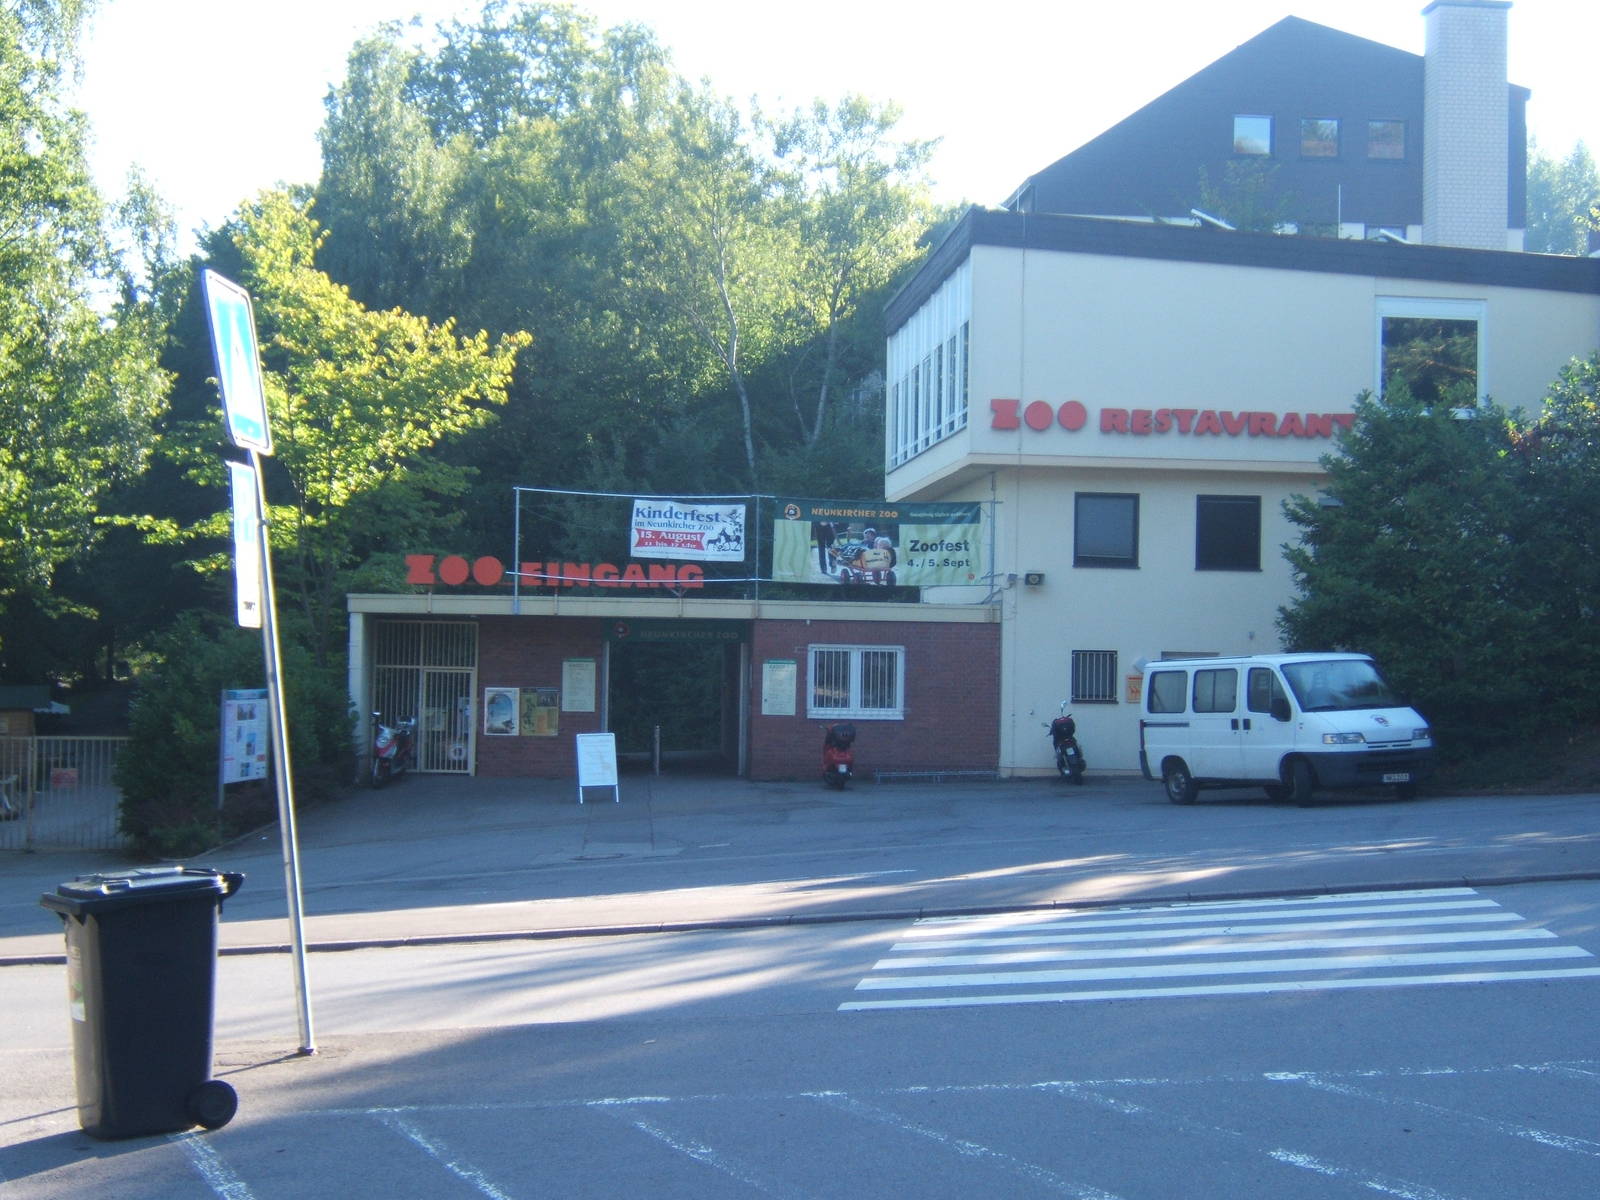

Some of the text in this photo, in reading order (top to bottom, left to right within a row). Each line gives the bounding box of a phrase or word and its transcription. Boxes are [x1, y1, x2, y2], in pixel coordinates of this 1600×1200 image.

[990, 398, 1087, 431] ZOO
[635, 506, 721, 523] Kinderfest
[811, 507, 876, 518] NEUNKIRCHER
[879, 510, 898, 518] ZOO
[634, 519, 645, 527] im
[647, 519, 698, 531] Neunkircher
[640, 530, 701, 543] 15. August
[909, 539, 969, 552] Zoofest
[943, 558, 970, 568] Sept
[404, 554, 704, 589] ZOO EINGANG
